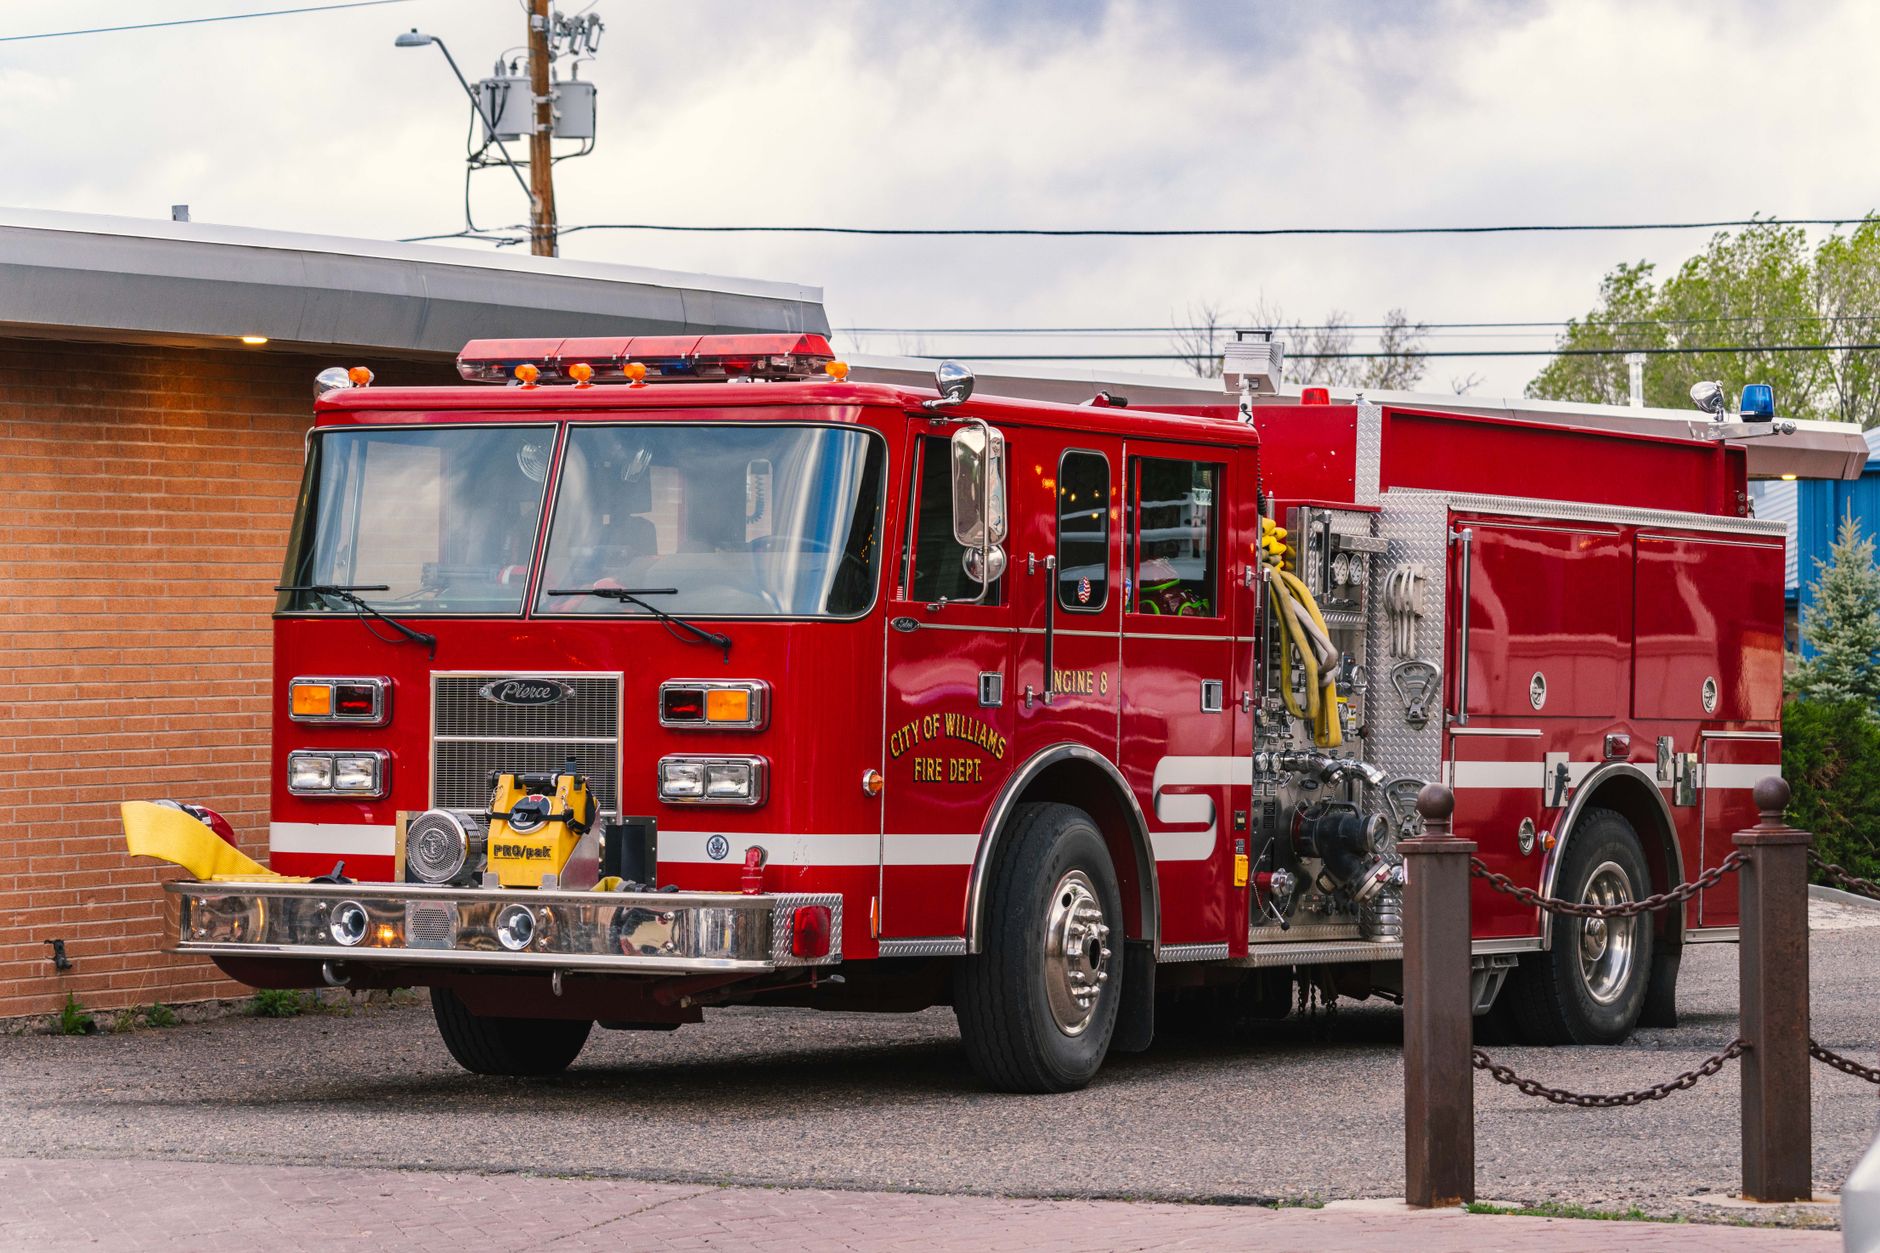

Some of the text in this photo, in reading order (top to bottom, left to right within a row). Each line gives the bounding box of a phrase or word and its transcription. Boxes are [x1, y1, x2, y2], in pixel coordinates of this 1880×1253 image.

[500, 681, 551, 700] Pierce
[1053, 670, 1108, 694] NGINE 8
[890, 712, 1006, 760] CITY OF WILLIAMS
[914, 757, 982, 782] FIRE DEPT.
